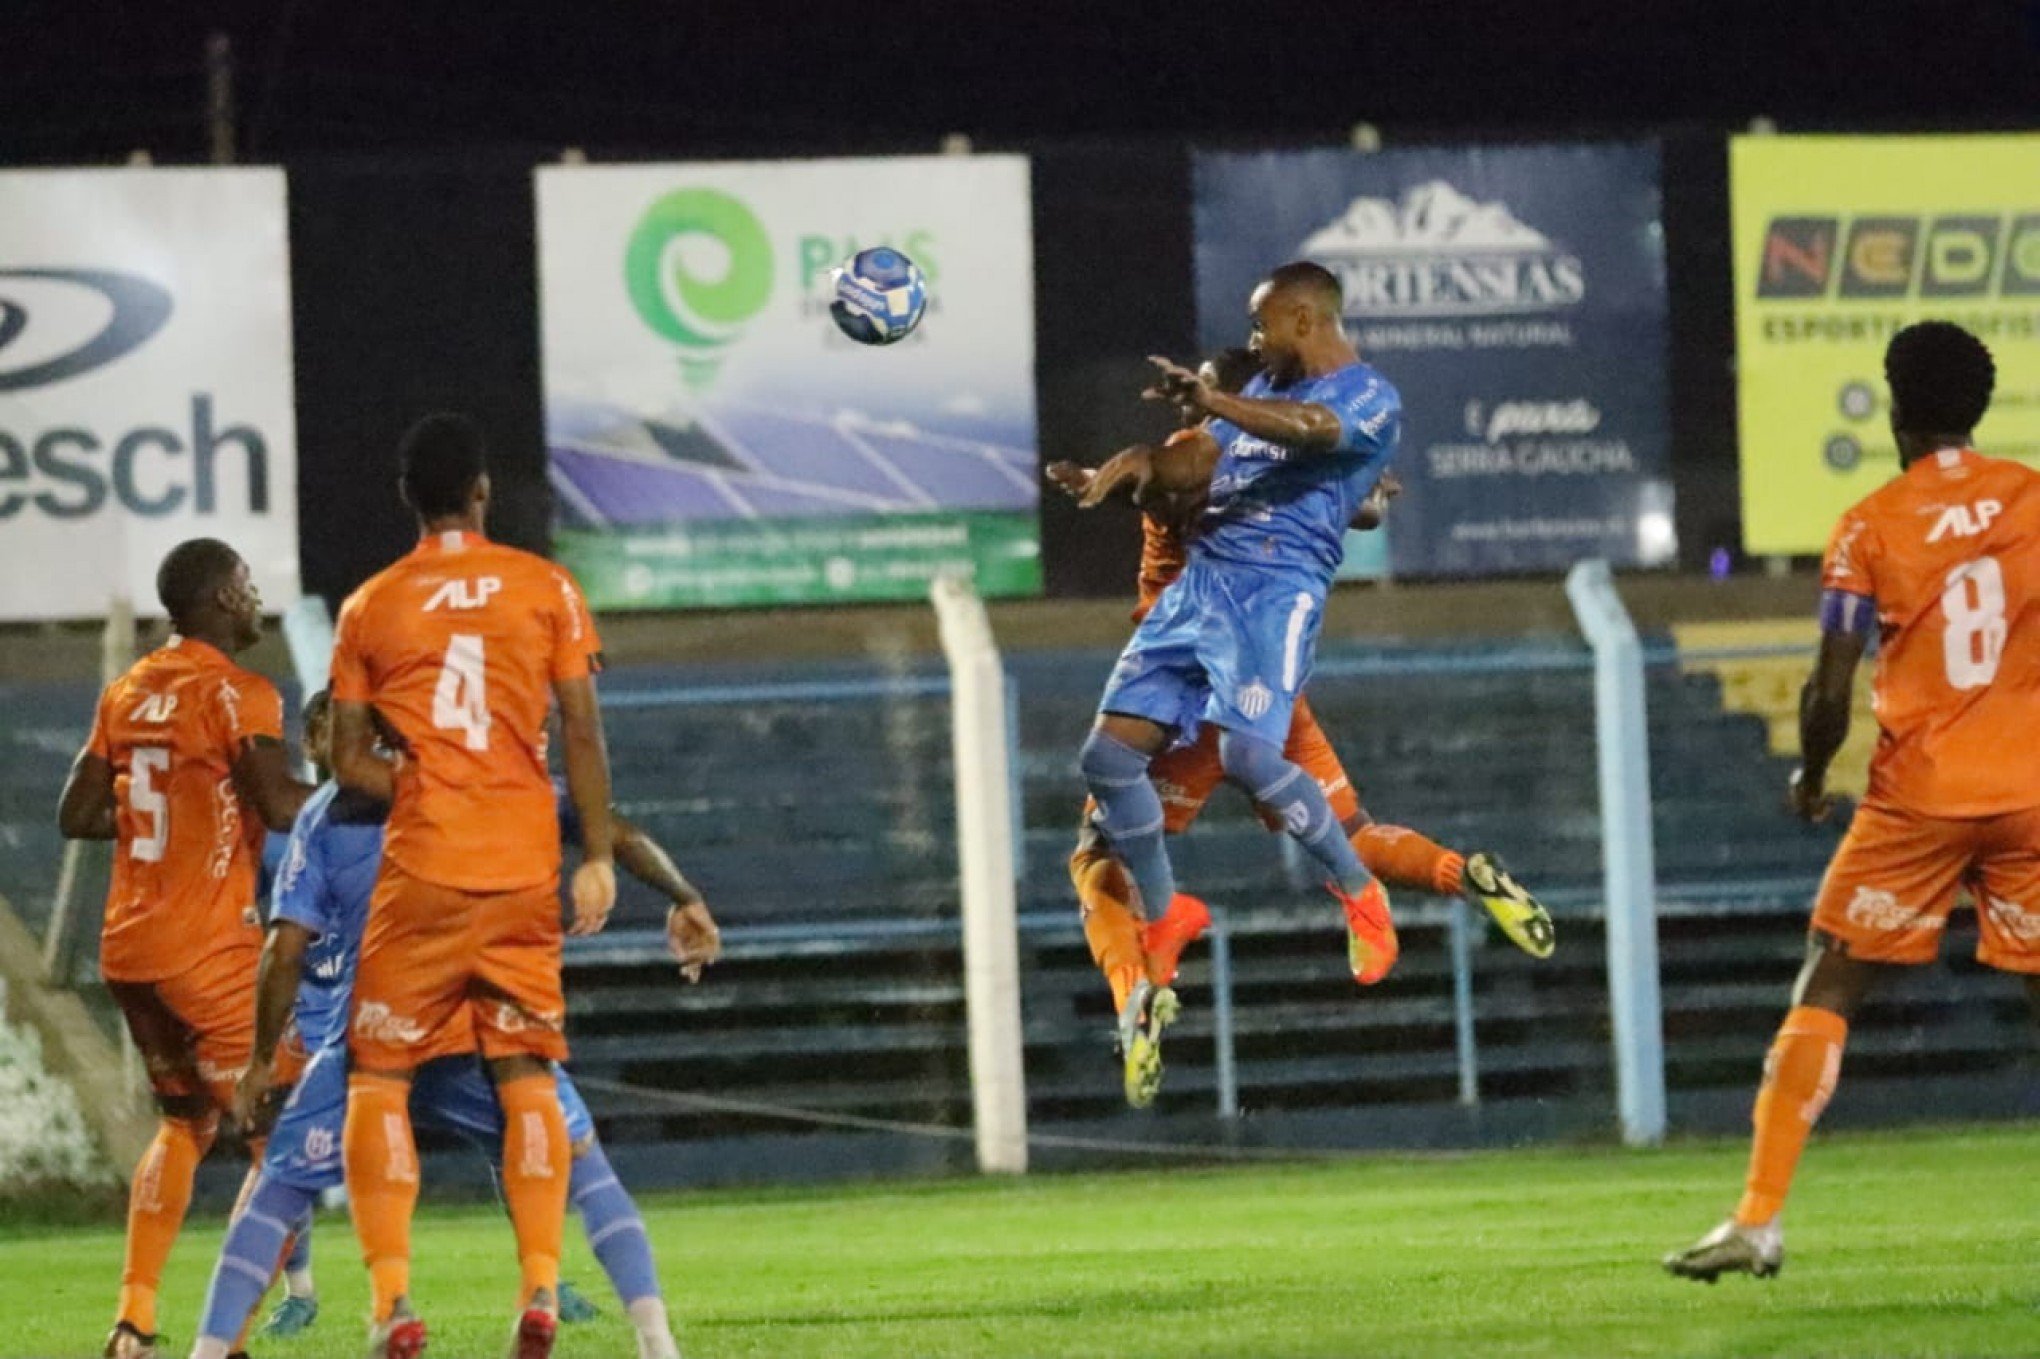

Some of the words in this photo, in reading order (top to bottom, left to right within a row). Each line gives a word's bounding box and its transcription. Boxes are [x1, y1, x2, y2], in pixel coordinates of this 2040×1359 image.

[1925, 499, 2003, 543] ALP
[421, 577, 502, 612] ALP
[1942, 557, 2008, 690] 8
[128, 693, 178, 722] ALP
[432, 633, 492, 752] 4
[129, 747, 170, 862] 5
